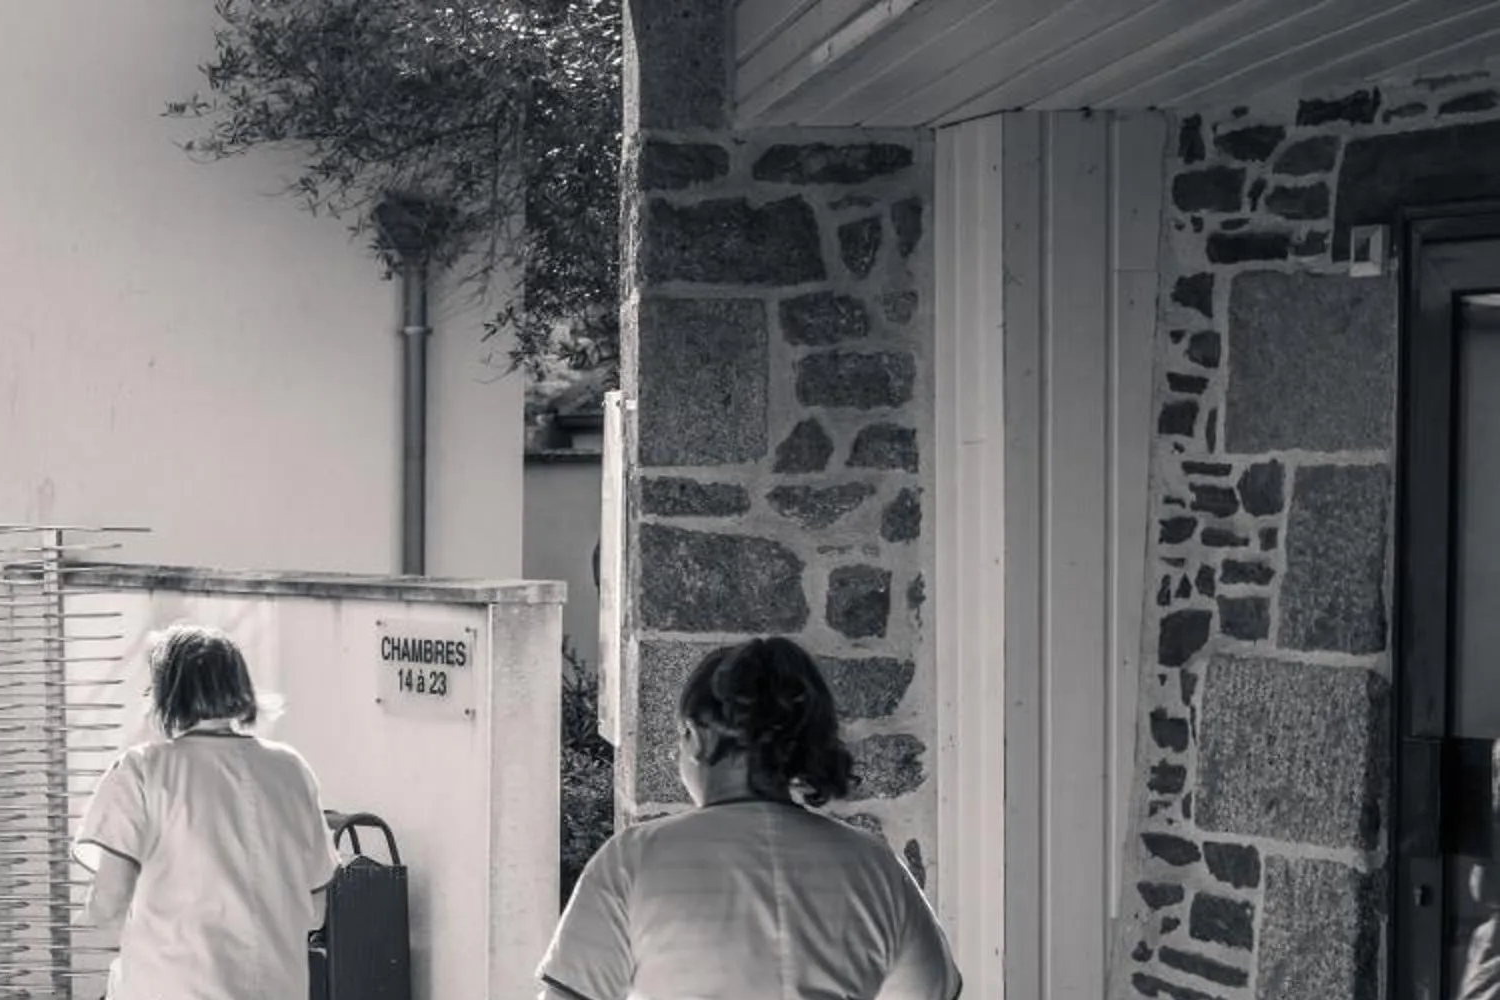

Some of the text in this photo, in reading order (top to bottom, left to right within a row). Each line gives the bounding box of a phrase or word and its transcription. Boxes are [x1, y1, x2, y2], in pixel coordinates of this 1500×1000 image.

[381, 636, 466, 667] CHAMBRES
[398, 669, 448, 696] 14 à 23
